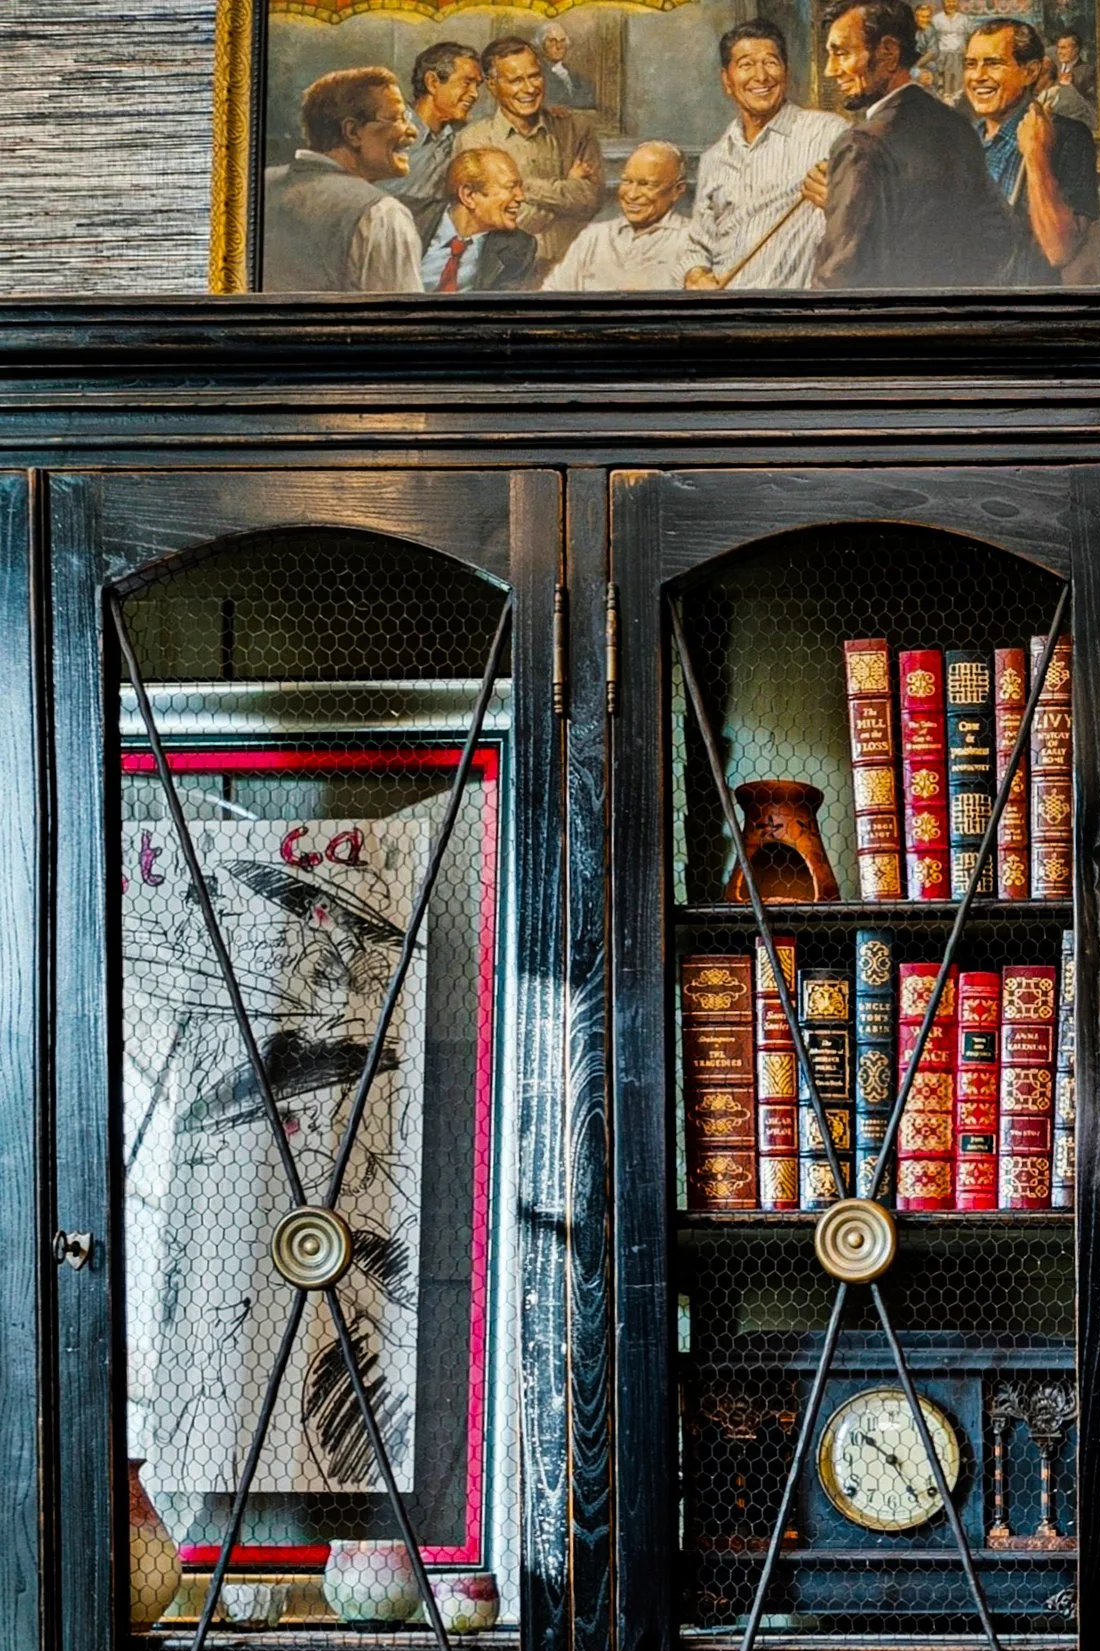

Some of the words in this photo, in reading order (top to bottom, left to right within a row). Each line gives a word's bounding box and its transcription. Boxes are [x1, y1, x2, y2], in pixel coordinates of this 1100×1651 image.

[862, 708, 877, 716] The
[856, 719, 887, 729] MILL
[1033, 713, 1073, 729] LIVY
[1014, 1032, 1040, 1040] ANNA
[904, 1050, 950, 1062] PACE
[843, 1452, 853, 1467] 9
[867, 1488, 877, 1503] 7
[887, 1495, 898, 1511] 6
